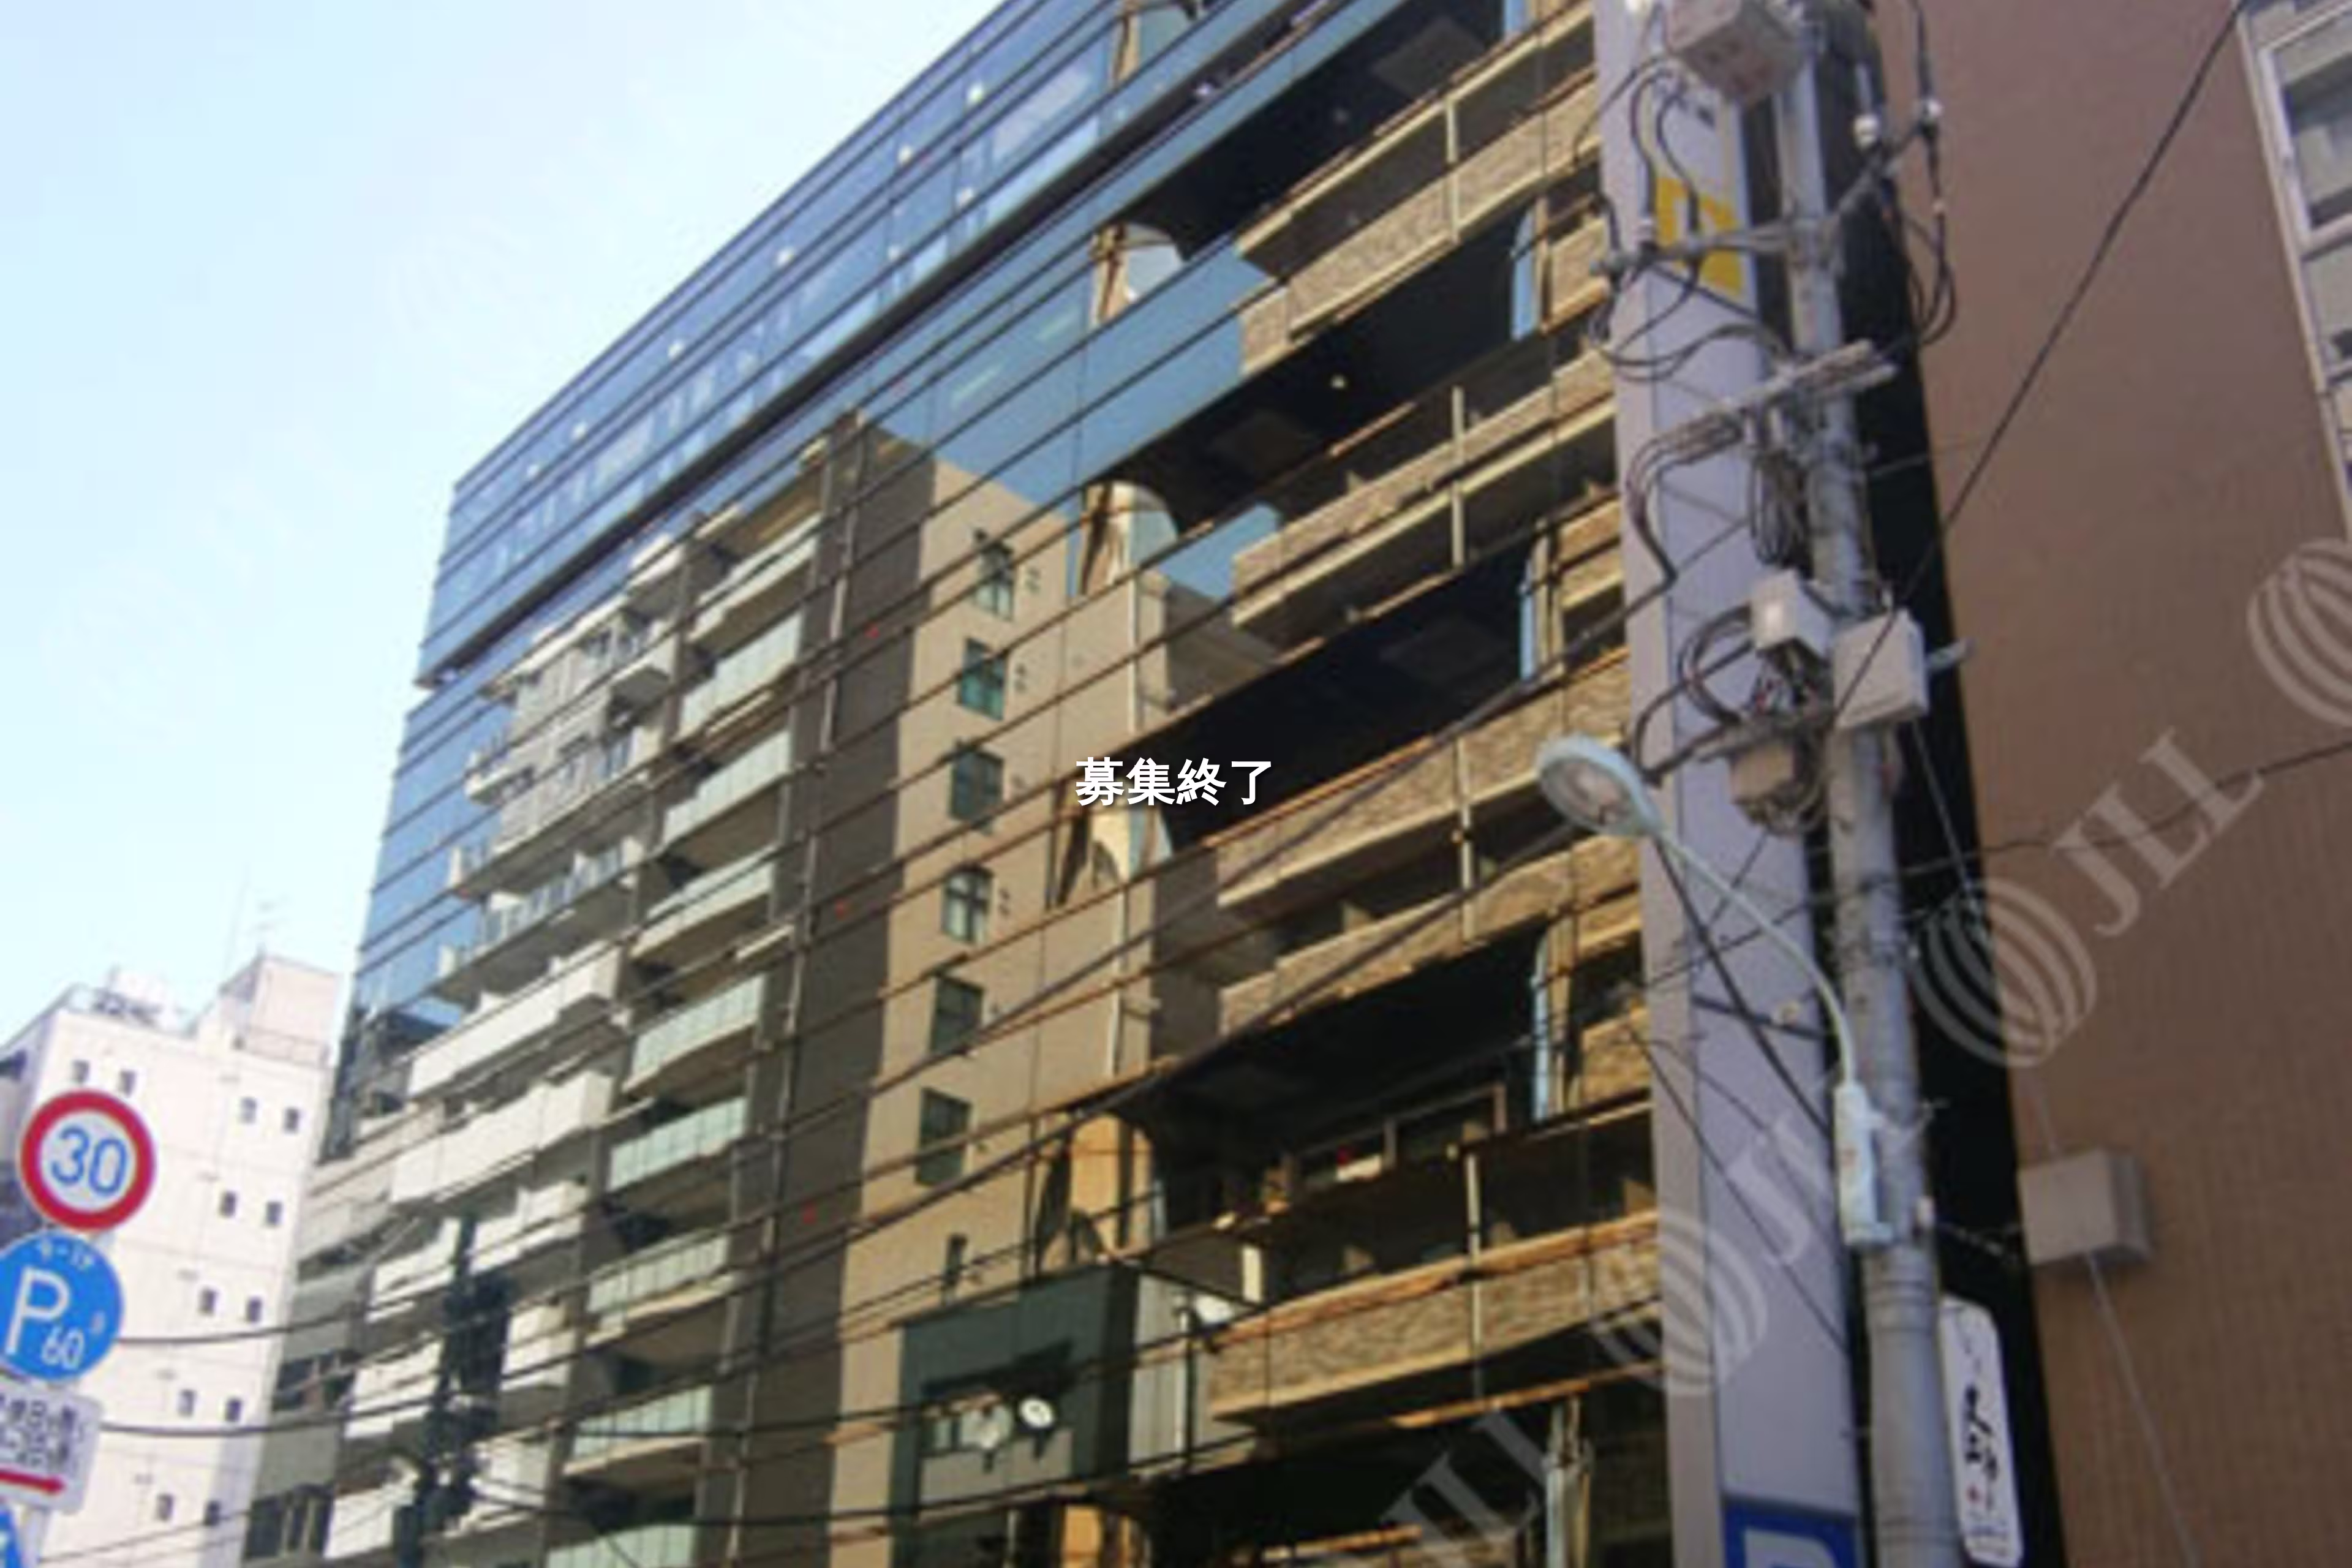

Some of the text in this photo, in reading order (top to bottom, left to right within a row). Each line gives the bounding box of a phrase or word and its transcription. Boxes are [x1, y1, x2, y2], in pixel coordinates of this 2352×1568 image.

[51, 1123, 127, 1197] 30
[5, 1265, 70, 1355] P
[40, 1323, 85, 1370] 60
